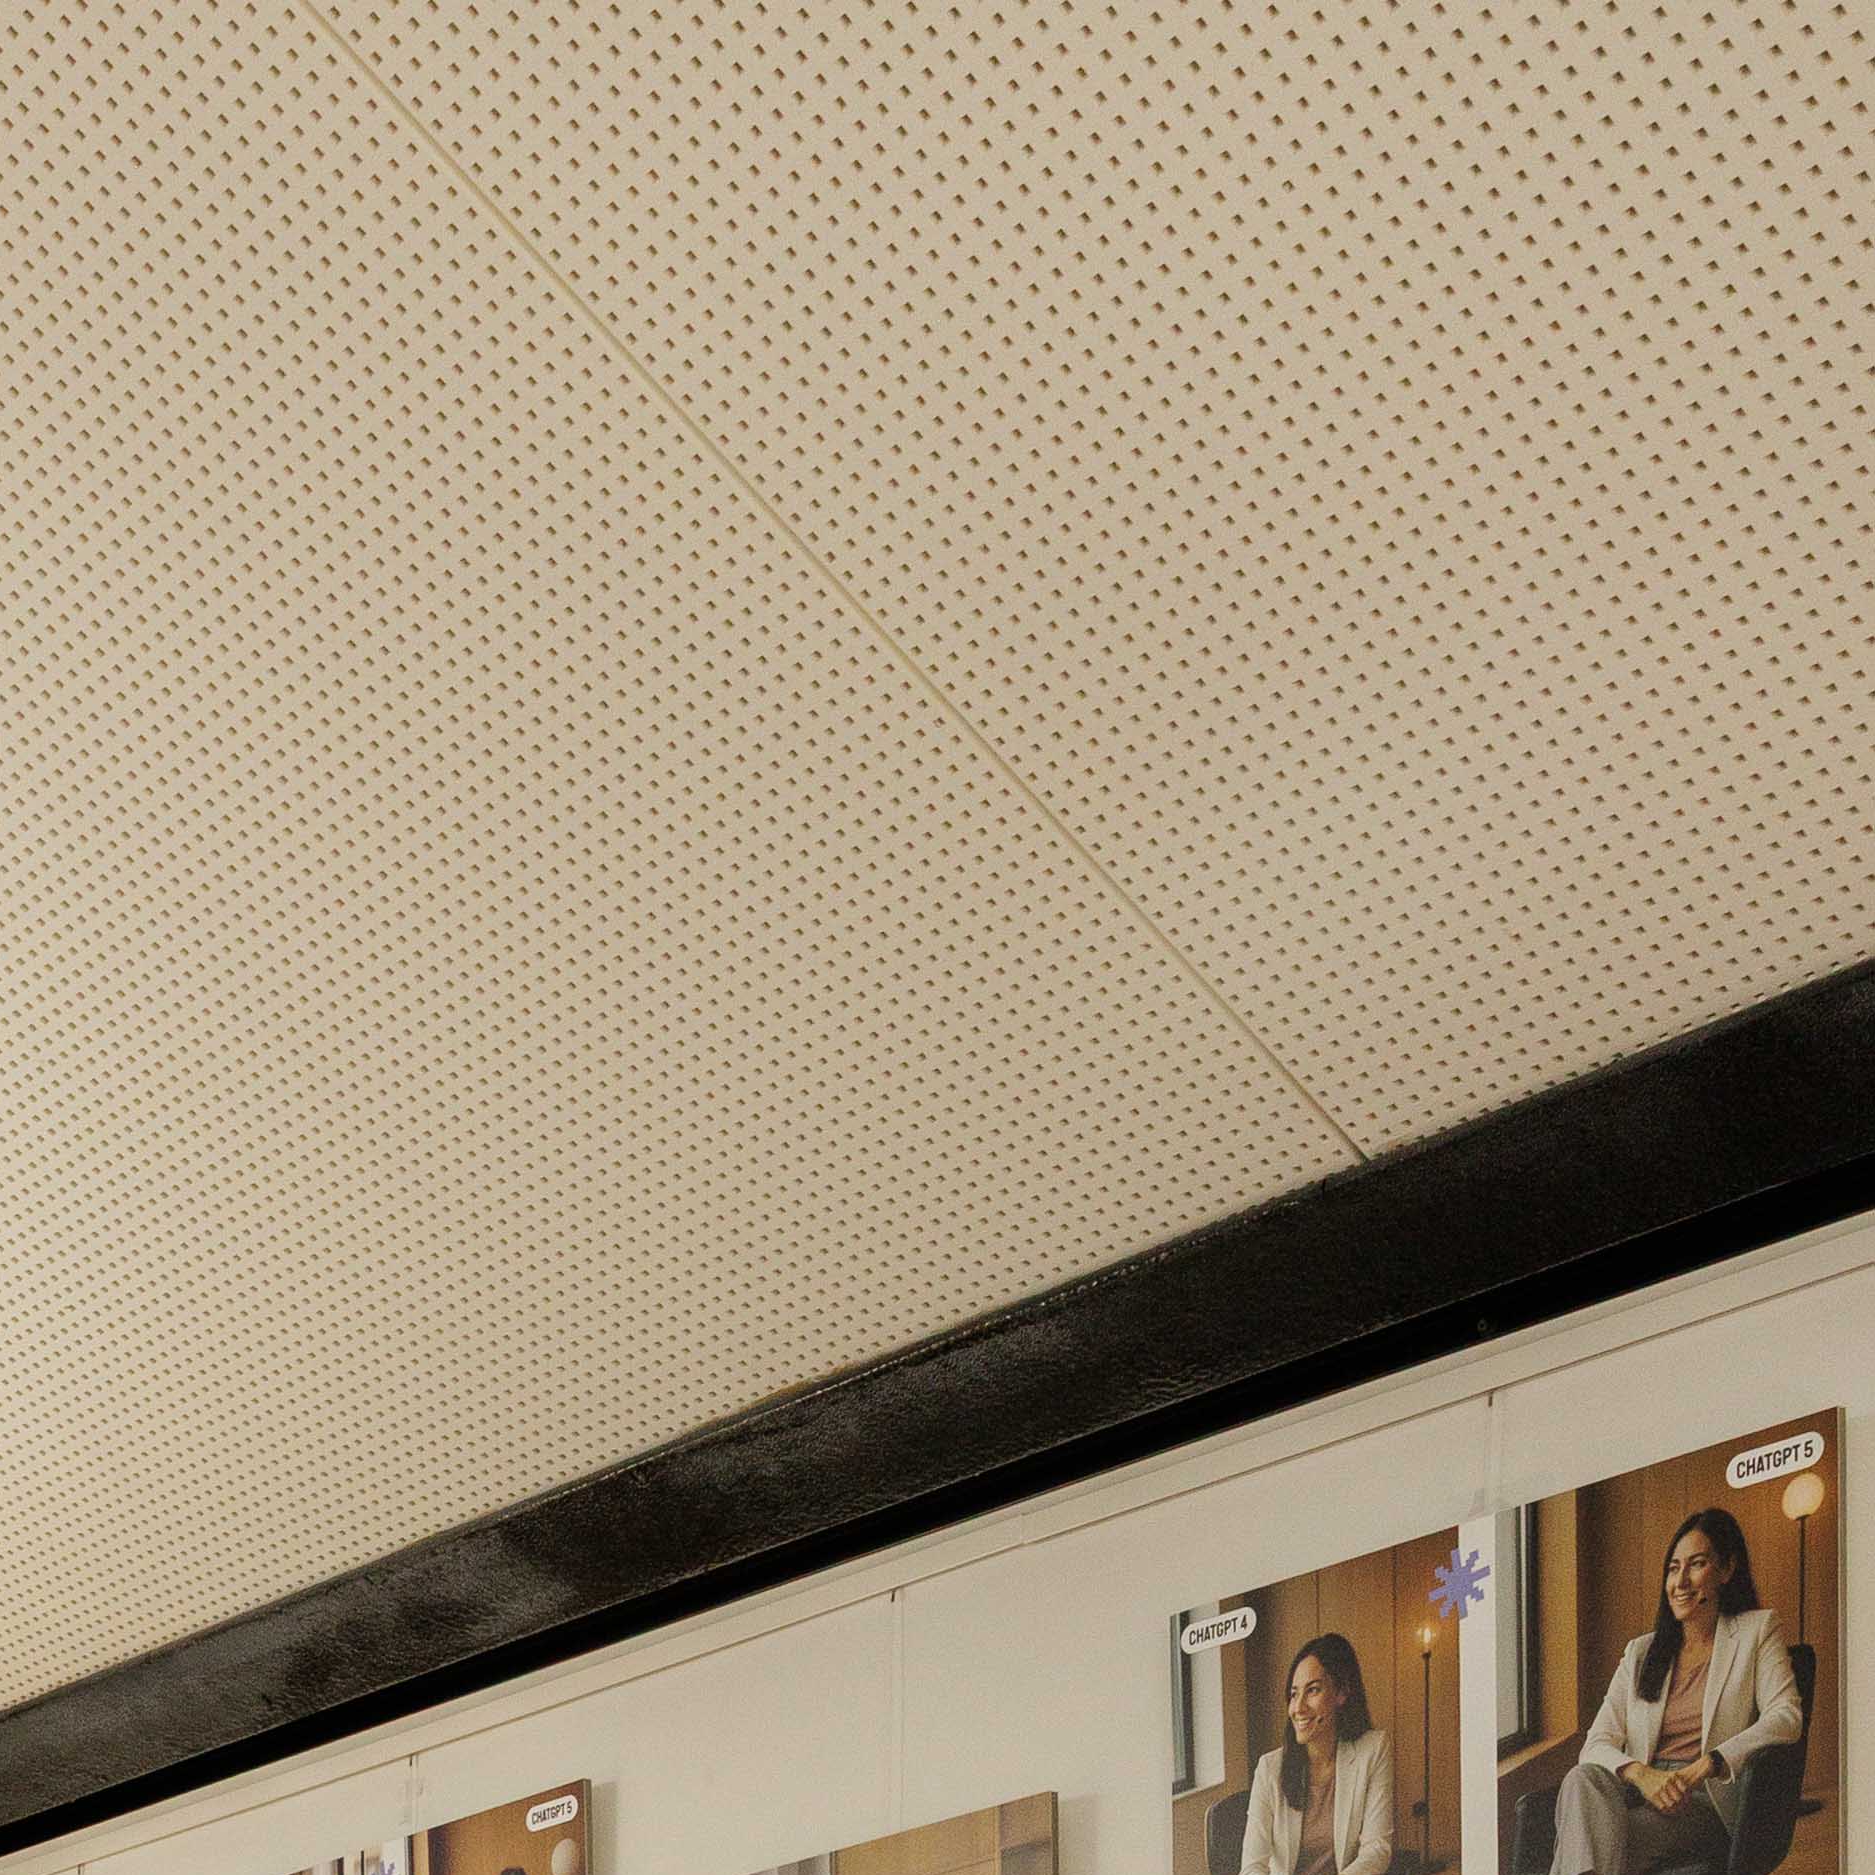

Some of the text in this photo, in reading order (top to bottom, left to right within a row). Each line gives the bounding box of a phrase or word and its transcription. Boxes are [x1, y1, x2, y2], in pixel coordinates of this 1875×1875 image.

[1736, 1440, 1814, 1479] CHATGPT 5
[1188, 1614, 1248, 1642] CHATGPT 4
[532, 1801, 572, 1825] CHATGPT 5
